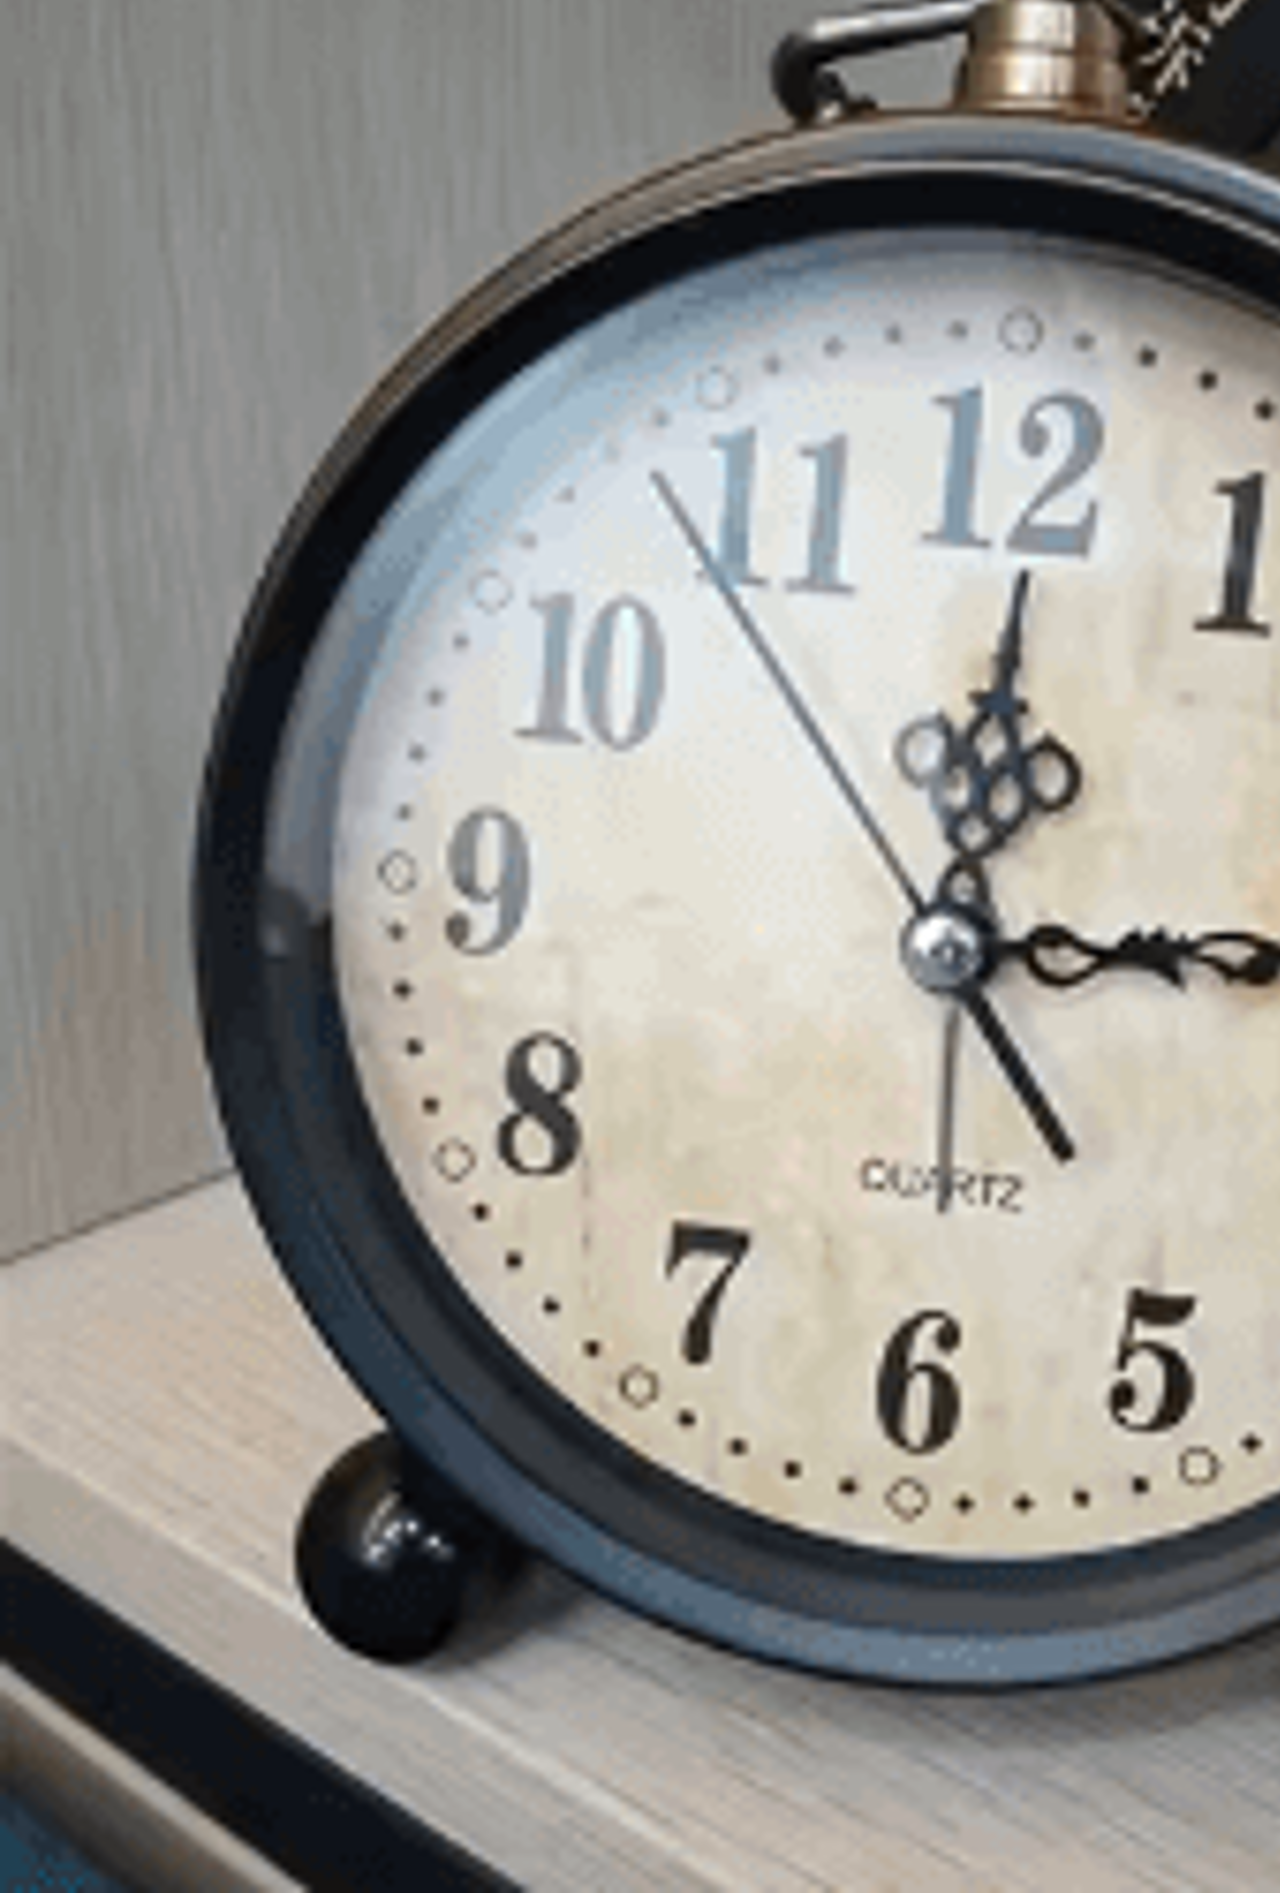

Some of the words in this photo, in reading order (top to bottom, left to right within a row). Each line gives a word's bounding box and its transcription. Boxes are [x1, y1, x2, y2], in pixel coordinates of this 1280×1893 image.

[697, 426, 858, 596] 11
[921, 385, 1107, 559] 12
[1192, 470, 1271, 638] 1
[513, 592, 666, 751] 10
[443, 806, 533, 957] 9
[497, 1031, 583, 1178] 8
[858, 1156, 1026, 1213] QUARTZ
[663, 1219, 751, 1364] 7
[1107, 1287, 1197, 1432] 5
[875, 1309, 963, 1456] 6
